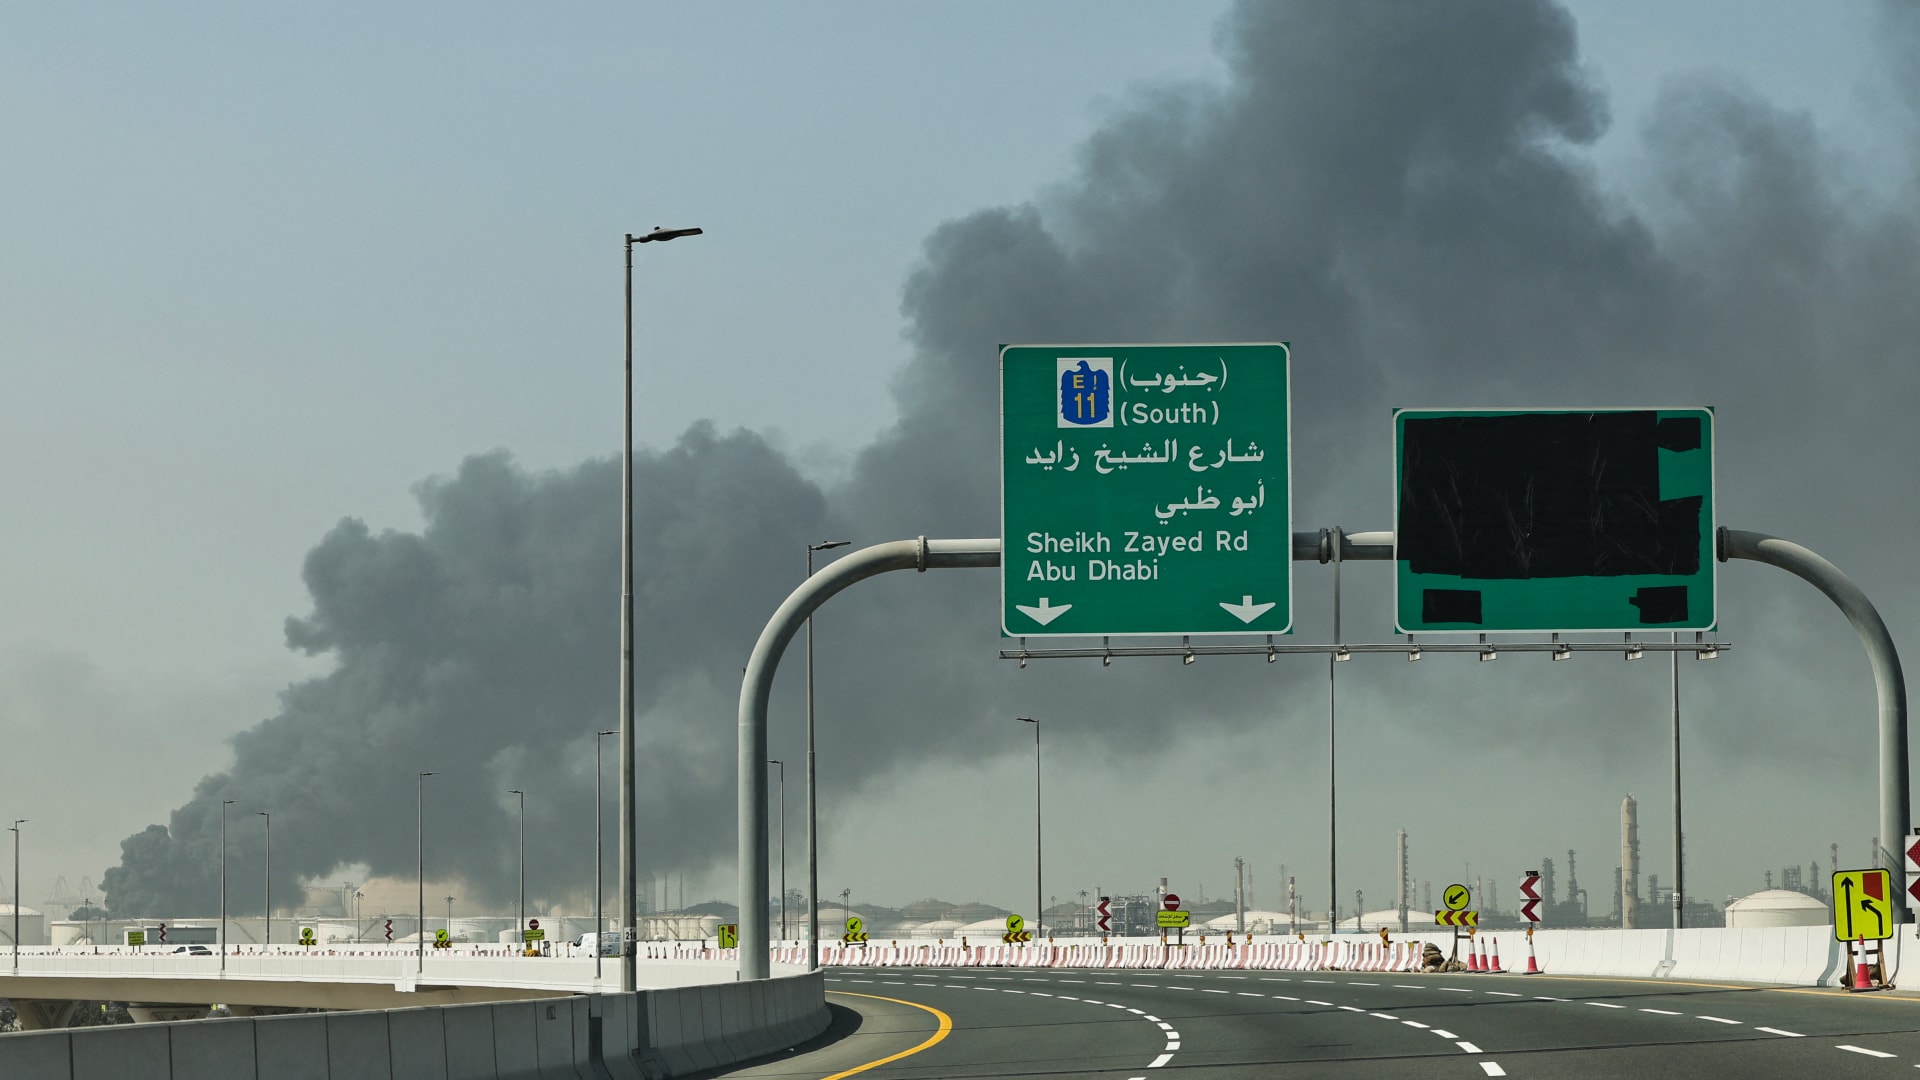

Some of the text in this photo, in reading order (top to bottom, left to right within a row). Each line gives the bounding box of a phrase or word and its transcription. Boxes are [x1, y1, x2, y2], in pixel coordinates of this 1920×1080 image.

[1073, 374, 1085, 389] E
[1119, 357, 1228, 393] (جنوب)
[1074, 392, 1095, 419] 11
[1120, 400, 1219, 426] (South)
[1025, 437, 1265, 474] شارع الشيخ زايد
[1155, 478, 1265, 525] أبو ظبي
[1026, 530, 1248, 556] Sheikh Zayed Rd
[1026, 558, 1158, 581] Abu Dhabi
